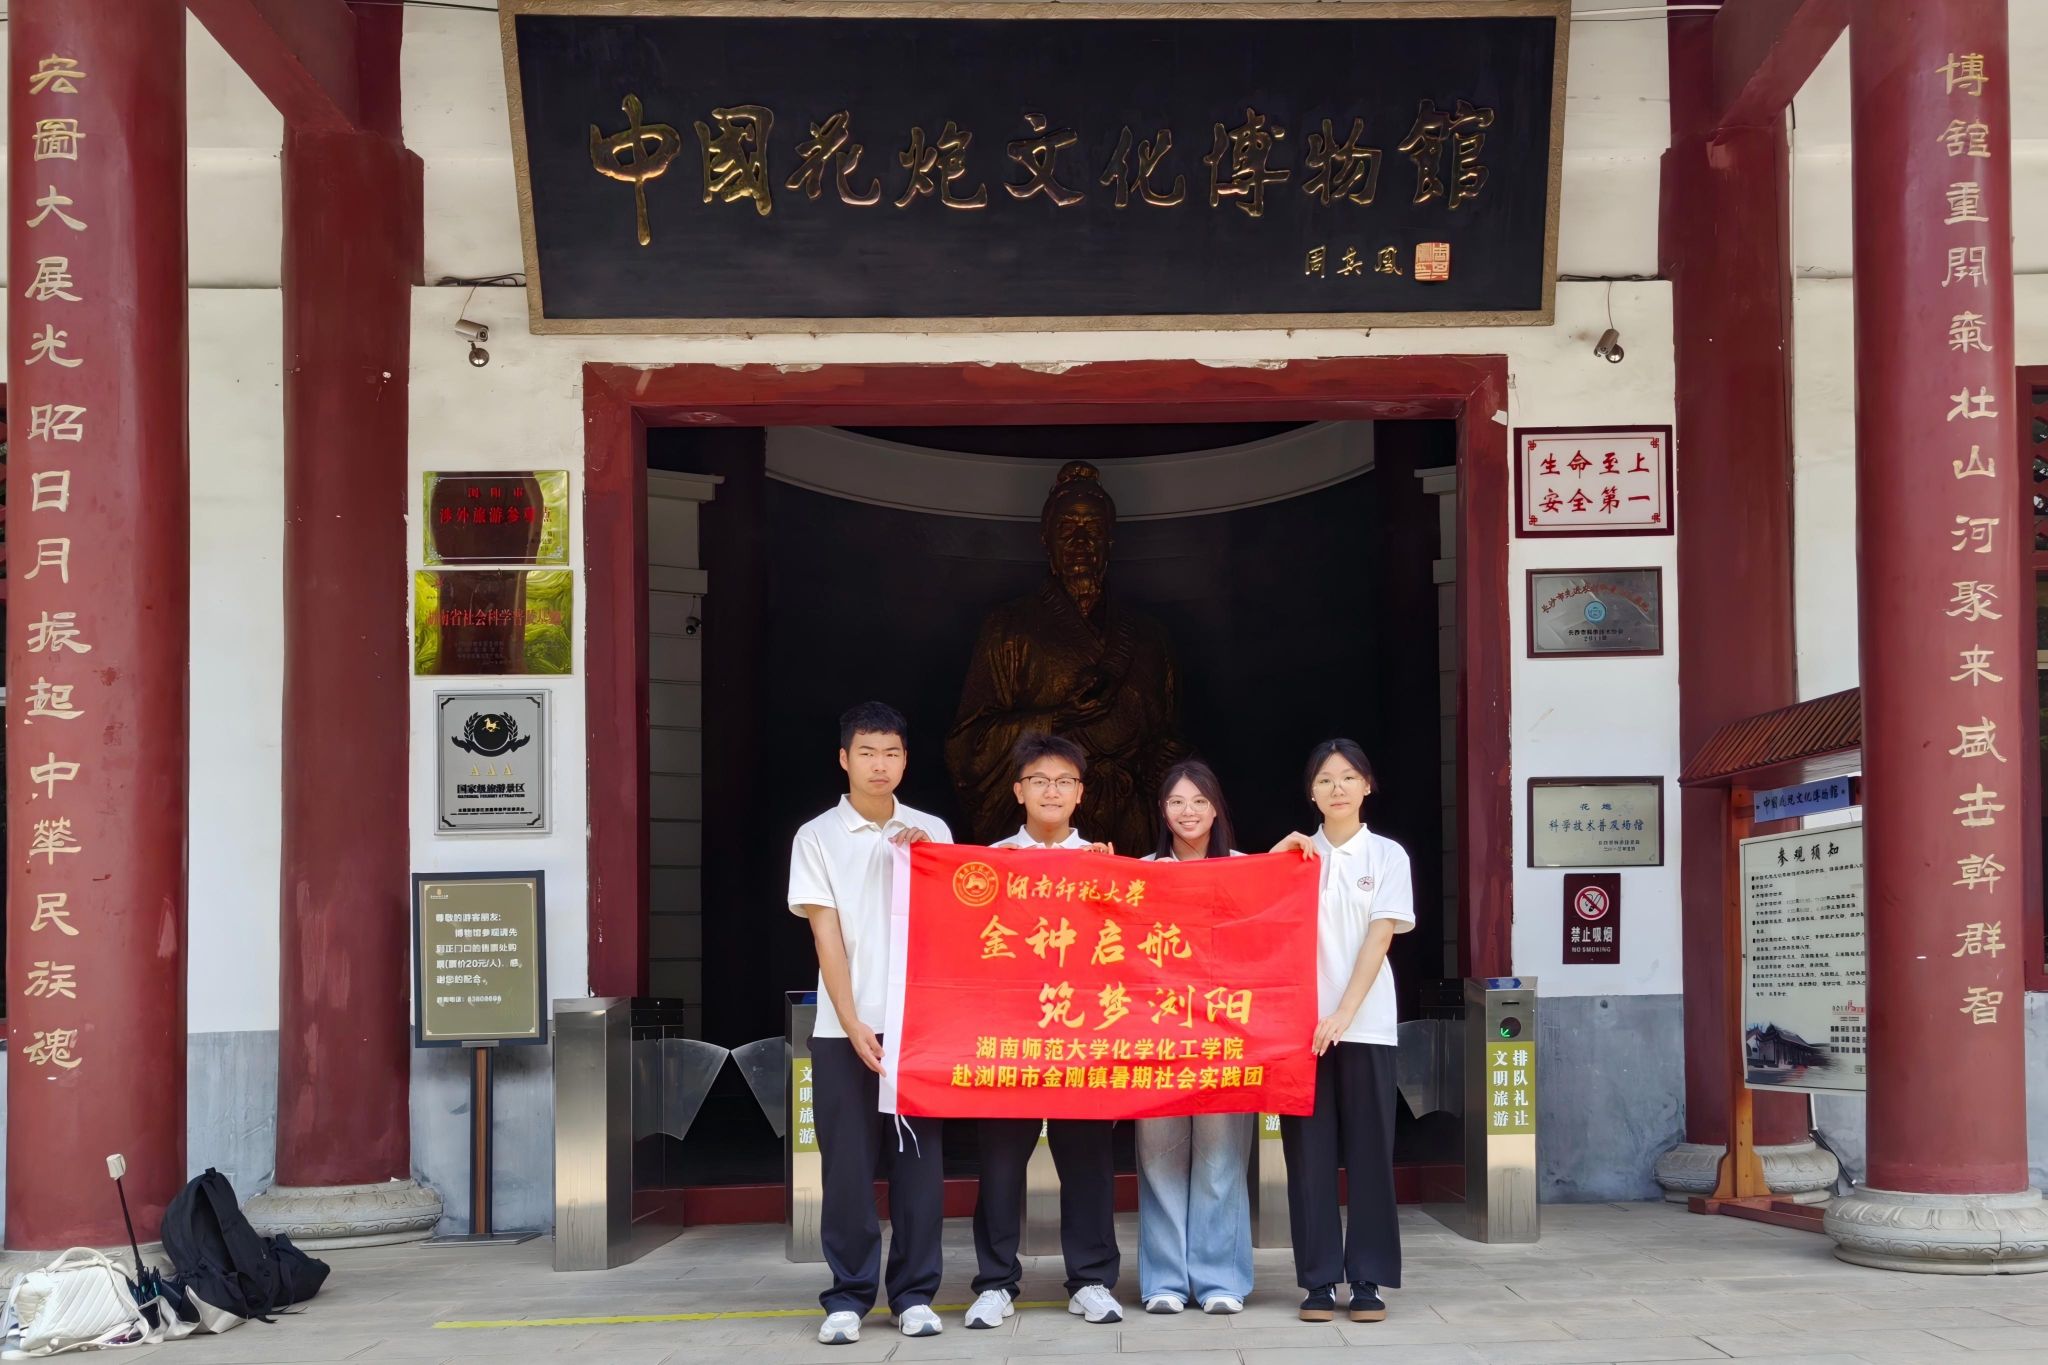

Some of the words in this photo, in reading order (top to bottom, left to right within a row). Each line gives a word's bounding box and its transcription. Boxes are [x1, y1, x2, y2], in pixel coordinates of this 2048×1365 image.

[1540, 450, 1650, 478] 生命至上
[1539, 486, 1650, 514] 安全第一
[1777, 841, 1839, 867] 参观须知
[980, 914, 1193, 970] 金种启航
[1571, 926, 1613, 943] 禁止吸烟
[1037, 982, 1253, 1030] 筑梦浏阳
[976, 1036, 1245, 1062] 湖南师范大学化学化工学院
[951, 1064, 1265, 1090] 赴浏阳市金刚镇暑期社会实践团
[1493, 1050, 1509, 1127] 文明旅游
[1512, 1050, 1529, 1127] 排队礼让
